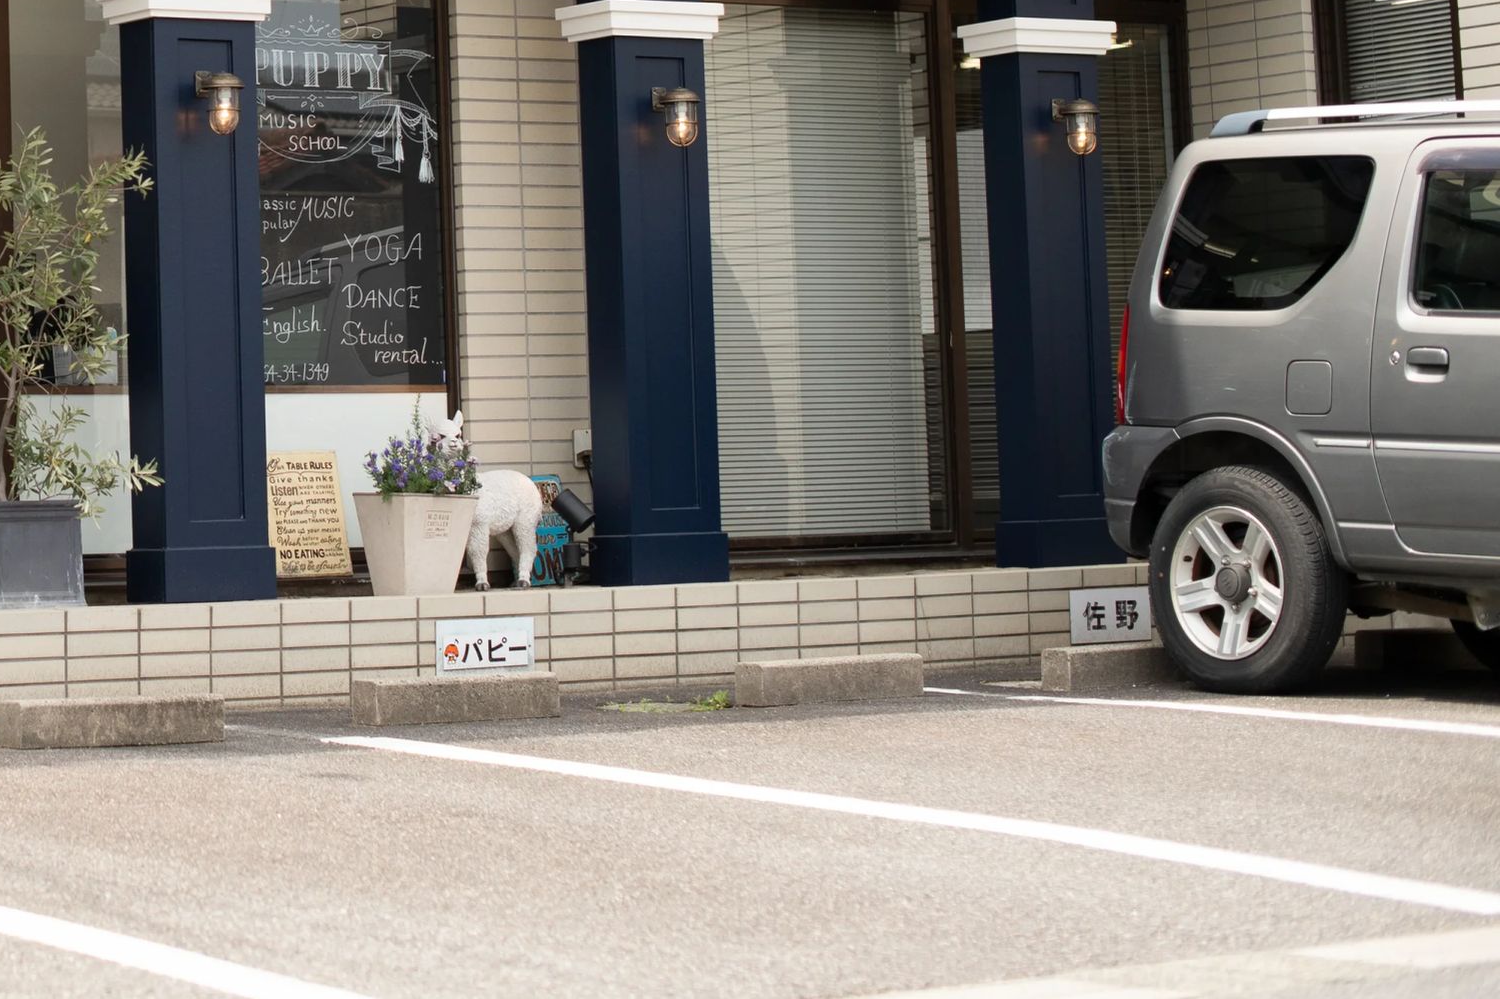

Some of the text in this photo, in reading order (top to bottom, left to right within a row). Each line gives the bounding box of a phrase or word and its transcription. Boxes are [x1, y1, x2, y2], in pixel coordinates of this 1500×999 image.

[259, 113, 317, 129] MUSIC
[288, 135, 348, 152] SCHOOL
[259, 193, 296, 210] assic
[262, 212, 296, 234] pular
[344, 233, 422, 266] YOGA
[261, 256, 339, 286] BALLET
[341, 283, 422, 309] DANCE
[340, 320, 404, 346] Studio
[286, 462, 308, 470] TABLE
[309, 461, 333, 470] RULES
[269, 474, 334, 484] Give thanks
[270, 485, 298, 496] Listen
[280, 549, 293, 559] NO
[294, 548, 326, 559] EATING
[1083, 600, 1139, 631] 佐野
[462, 637, 527, 663] パピー
